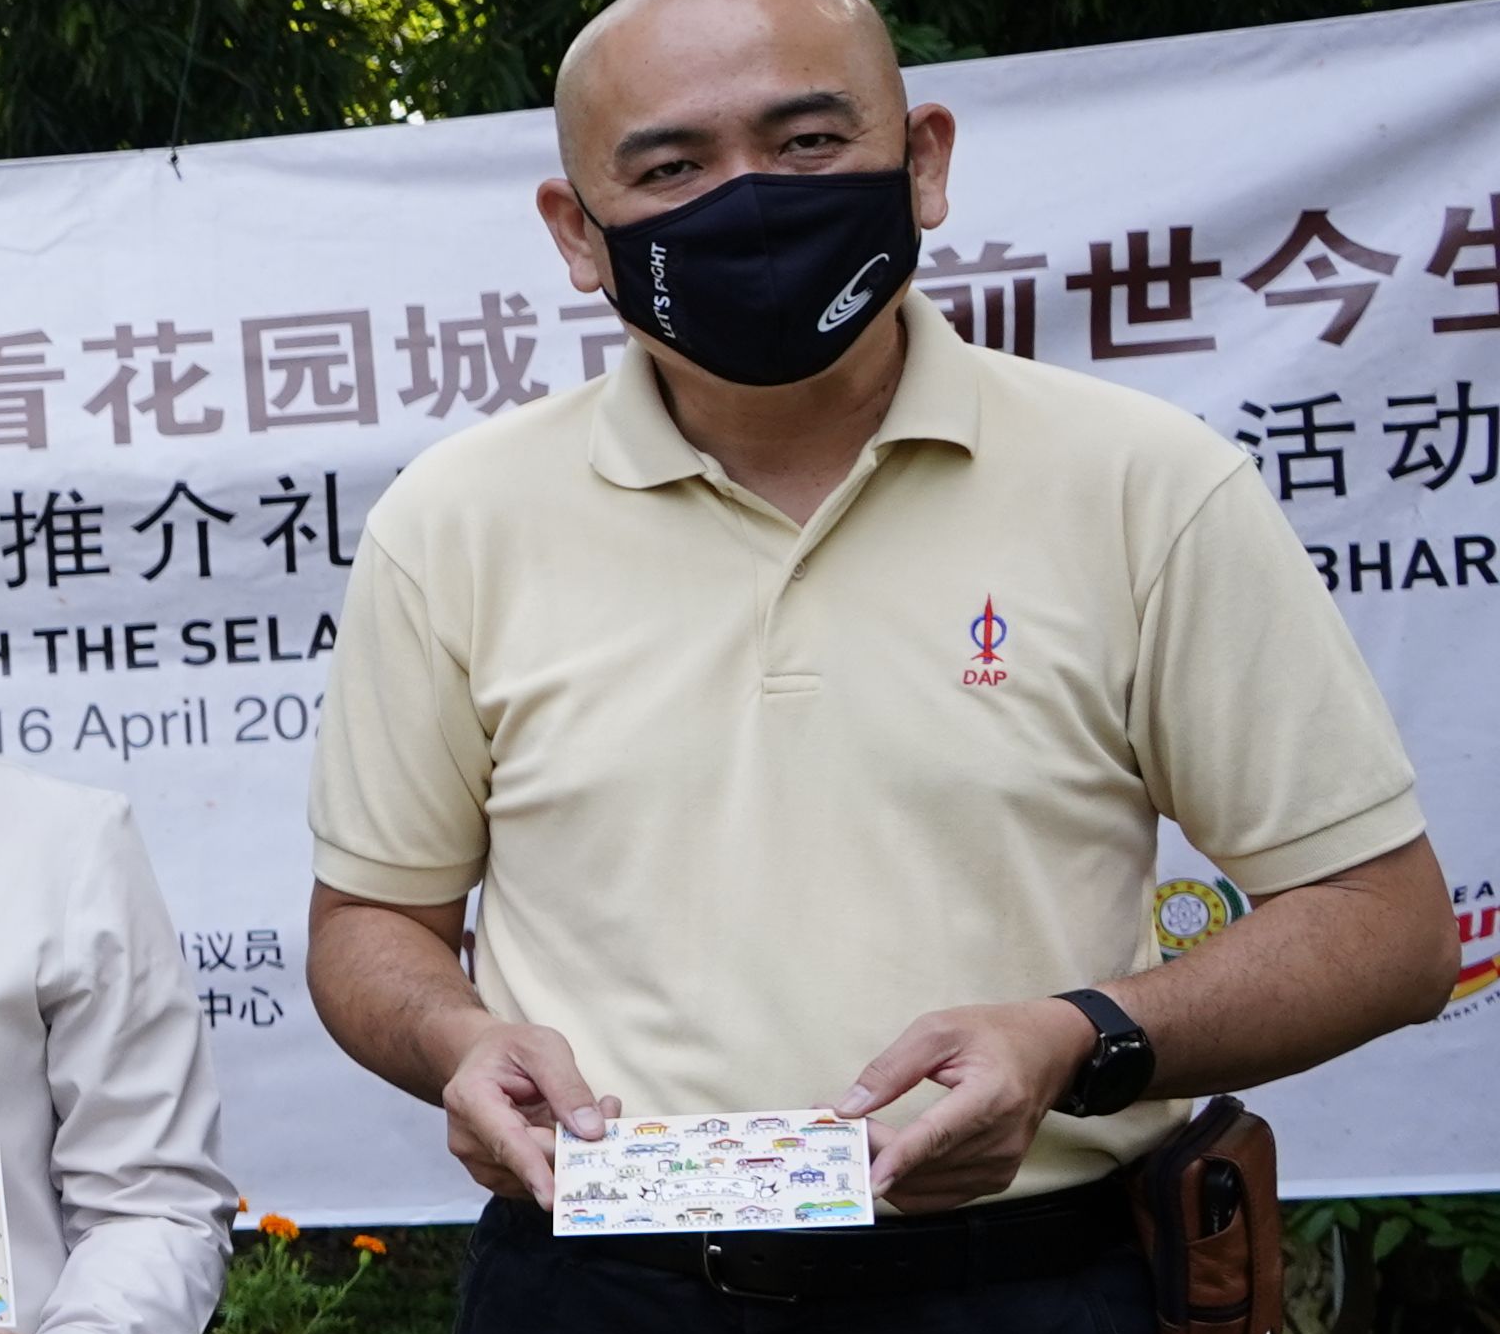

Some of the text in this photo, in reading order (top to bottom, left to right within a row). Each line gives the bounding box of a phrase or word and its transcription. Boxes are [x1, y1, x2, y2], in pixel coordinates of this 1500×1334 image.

[650, 241, 669, 294] FGHT
[33, 623, 161, 675] THE
[963, 670, 1007, 687] DAP
[74, 699, 209, 762] April
